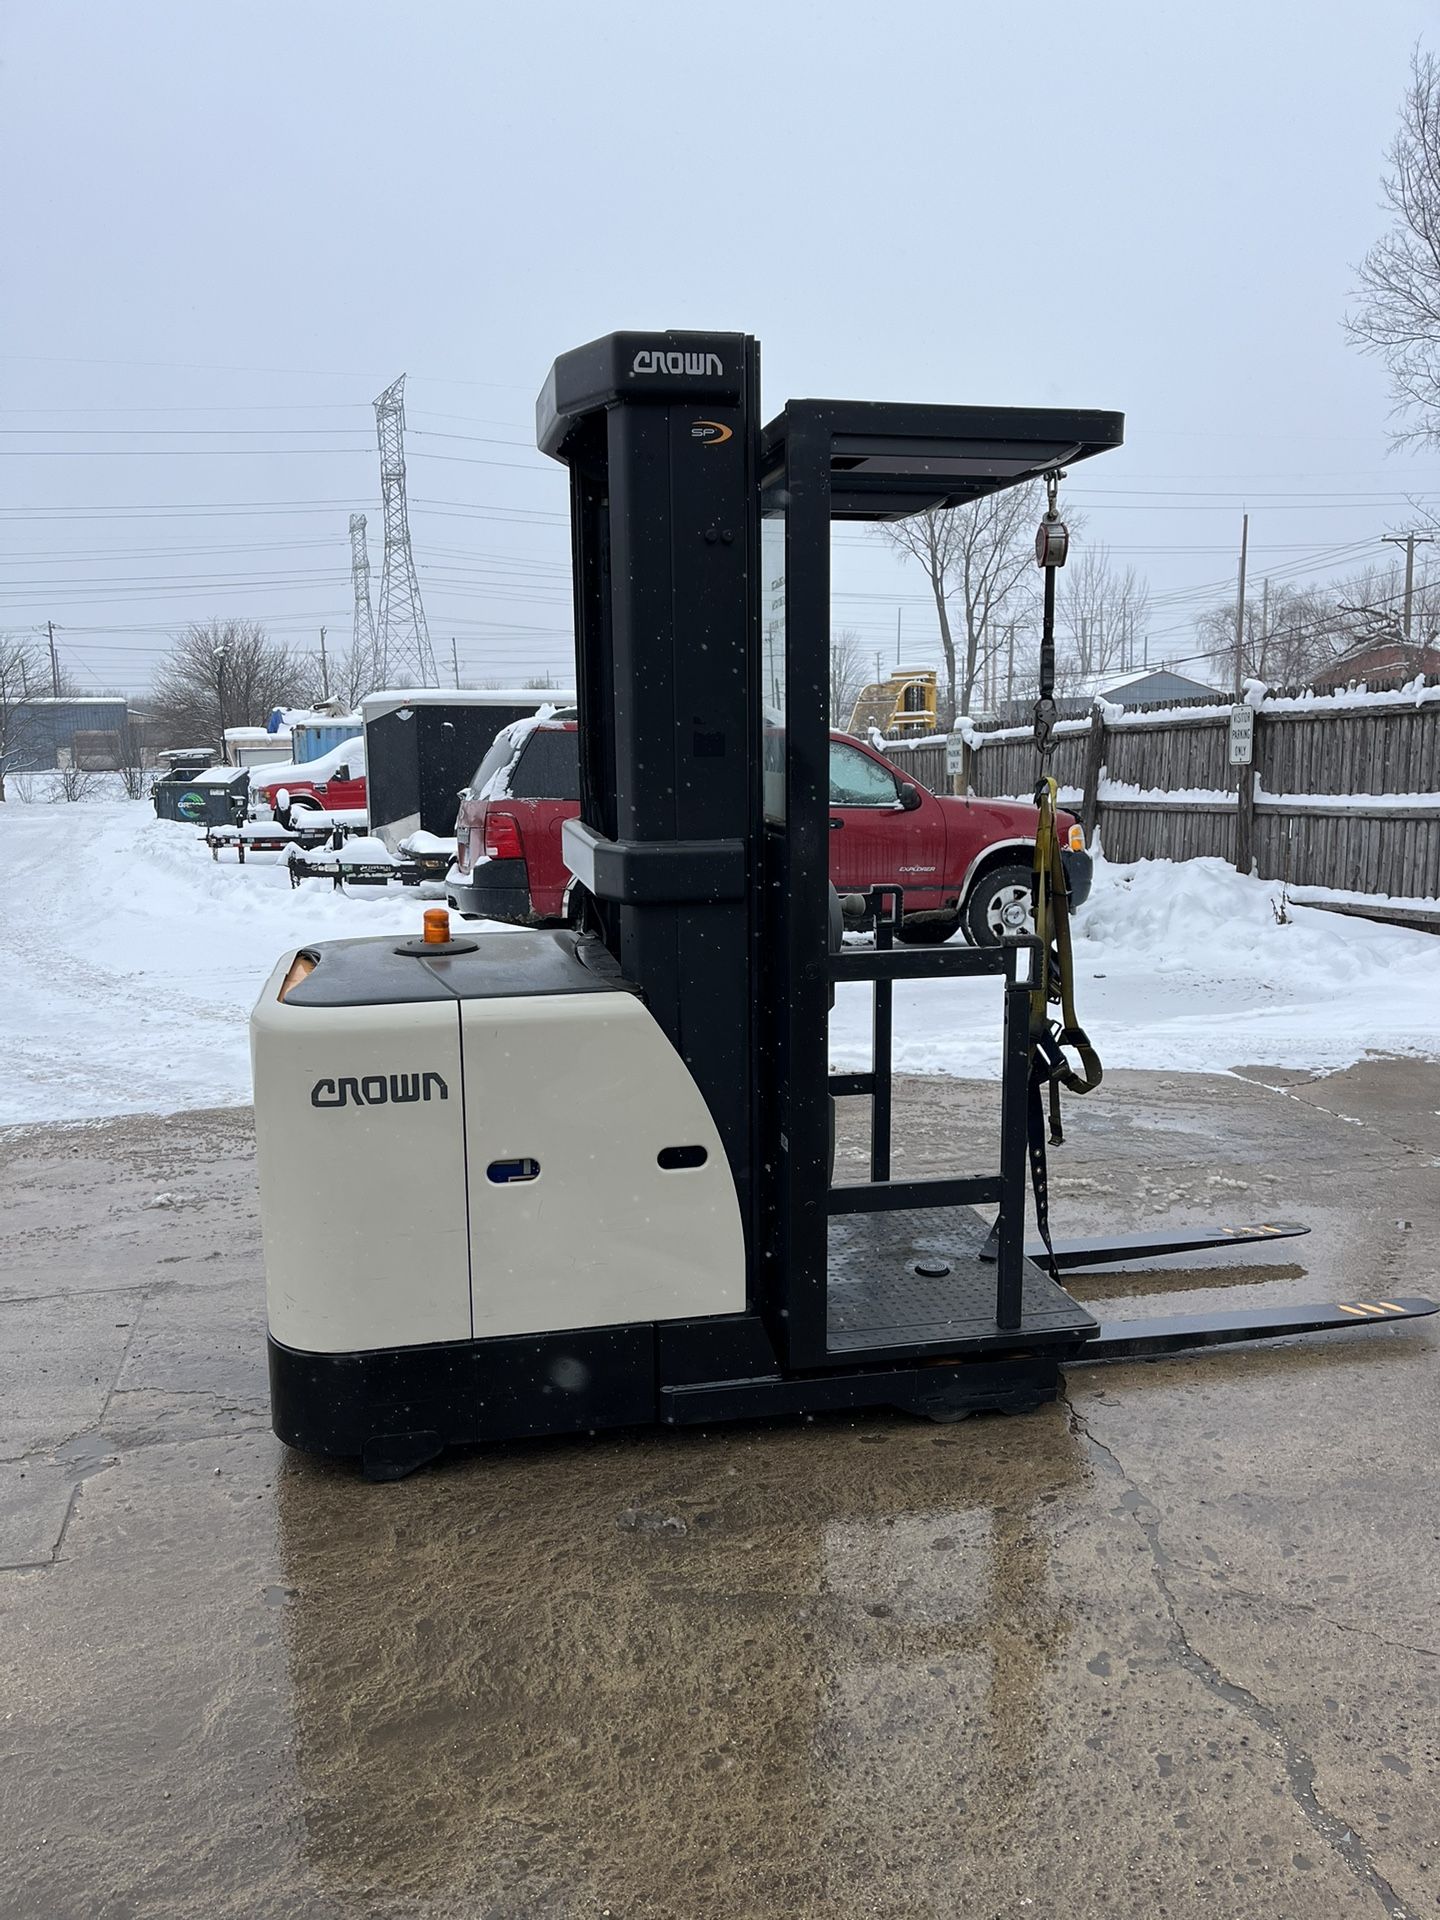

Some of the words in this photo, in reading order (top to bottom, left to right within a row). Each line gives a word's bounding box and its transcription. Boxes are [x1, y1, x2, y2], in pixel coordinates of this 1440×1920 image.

[633, 350, 723, 376] CROWN
[691, 428, 715, 437] SP
[1233, 711, 1251, 724] VISITOR
[1232, 728, 1250, 740] PARKING
[1234, 745, 1247, 757] ONLY
[311, 1072, 448, 1108] CROWN
